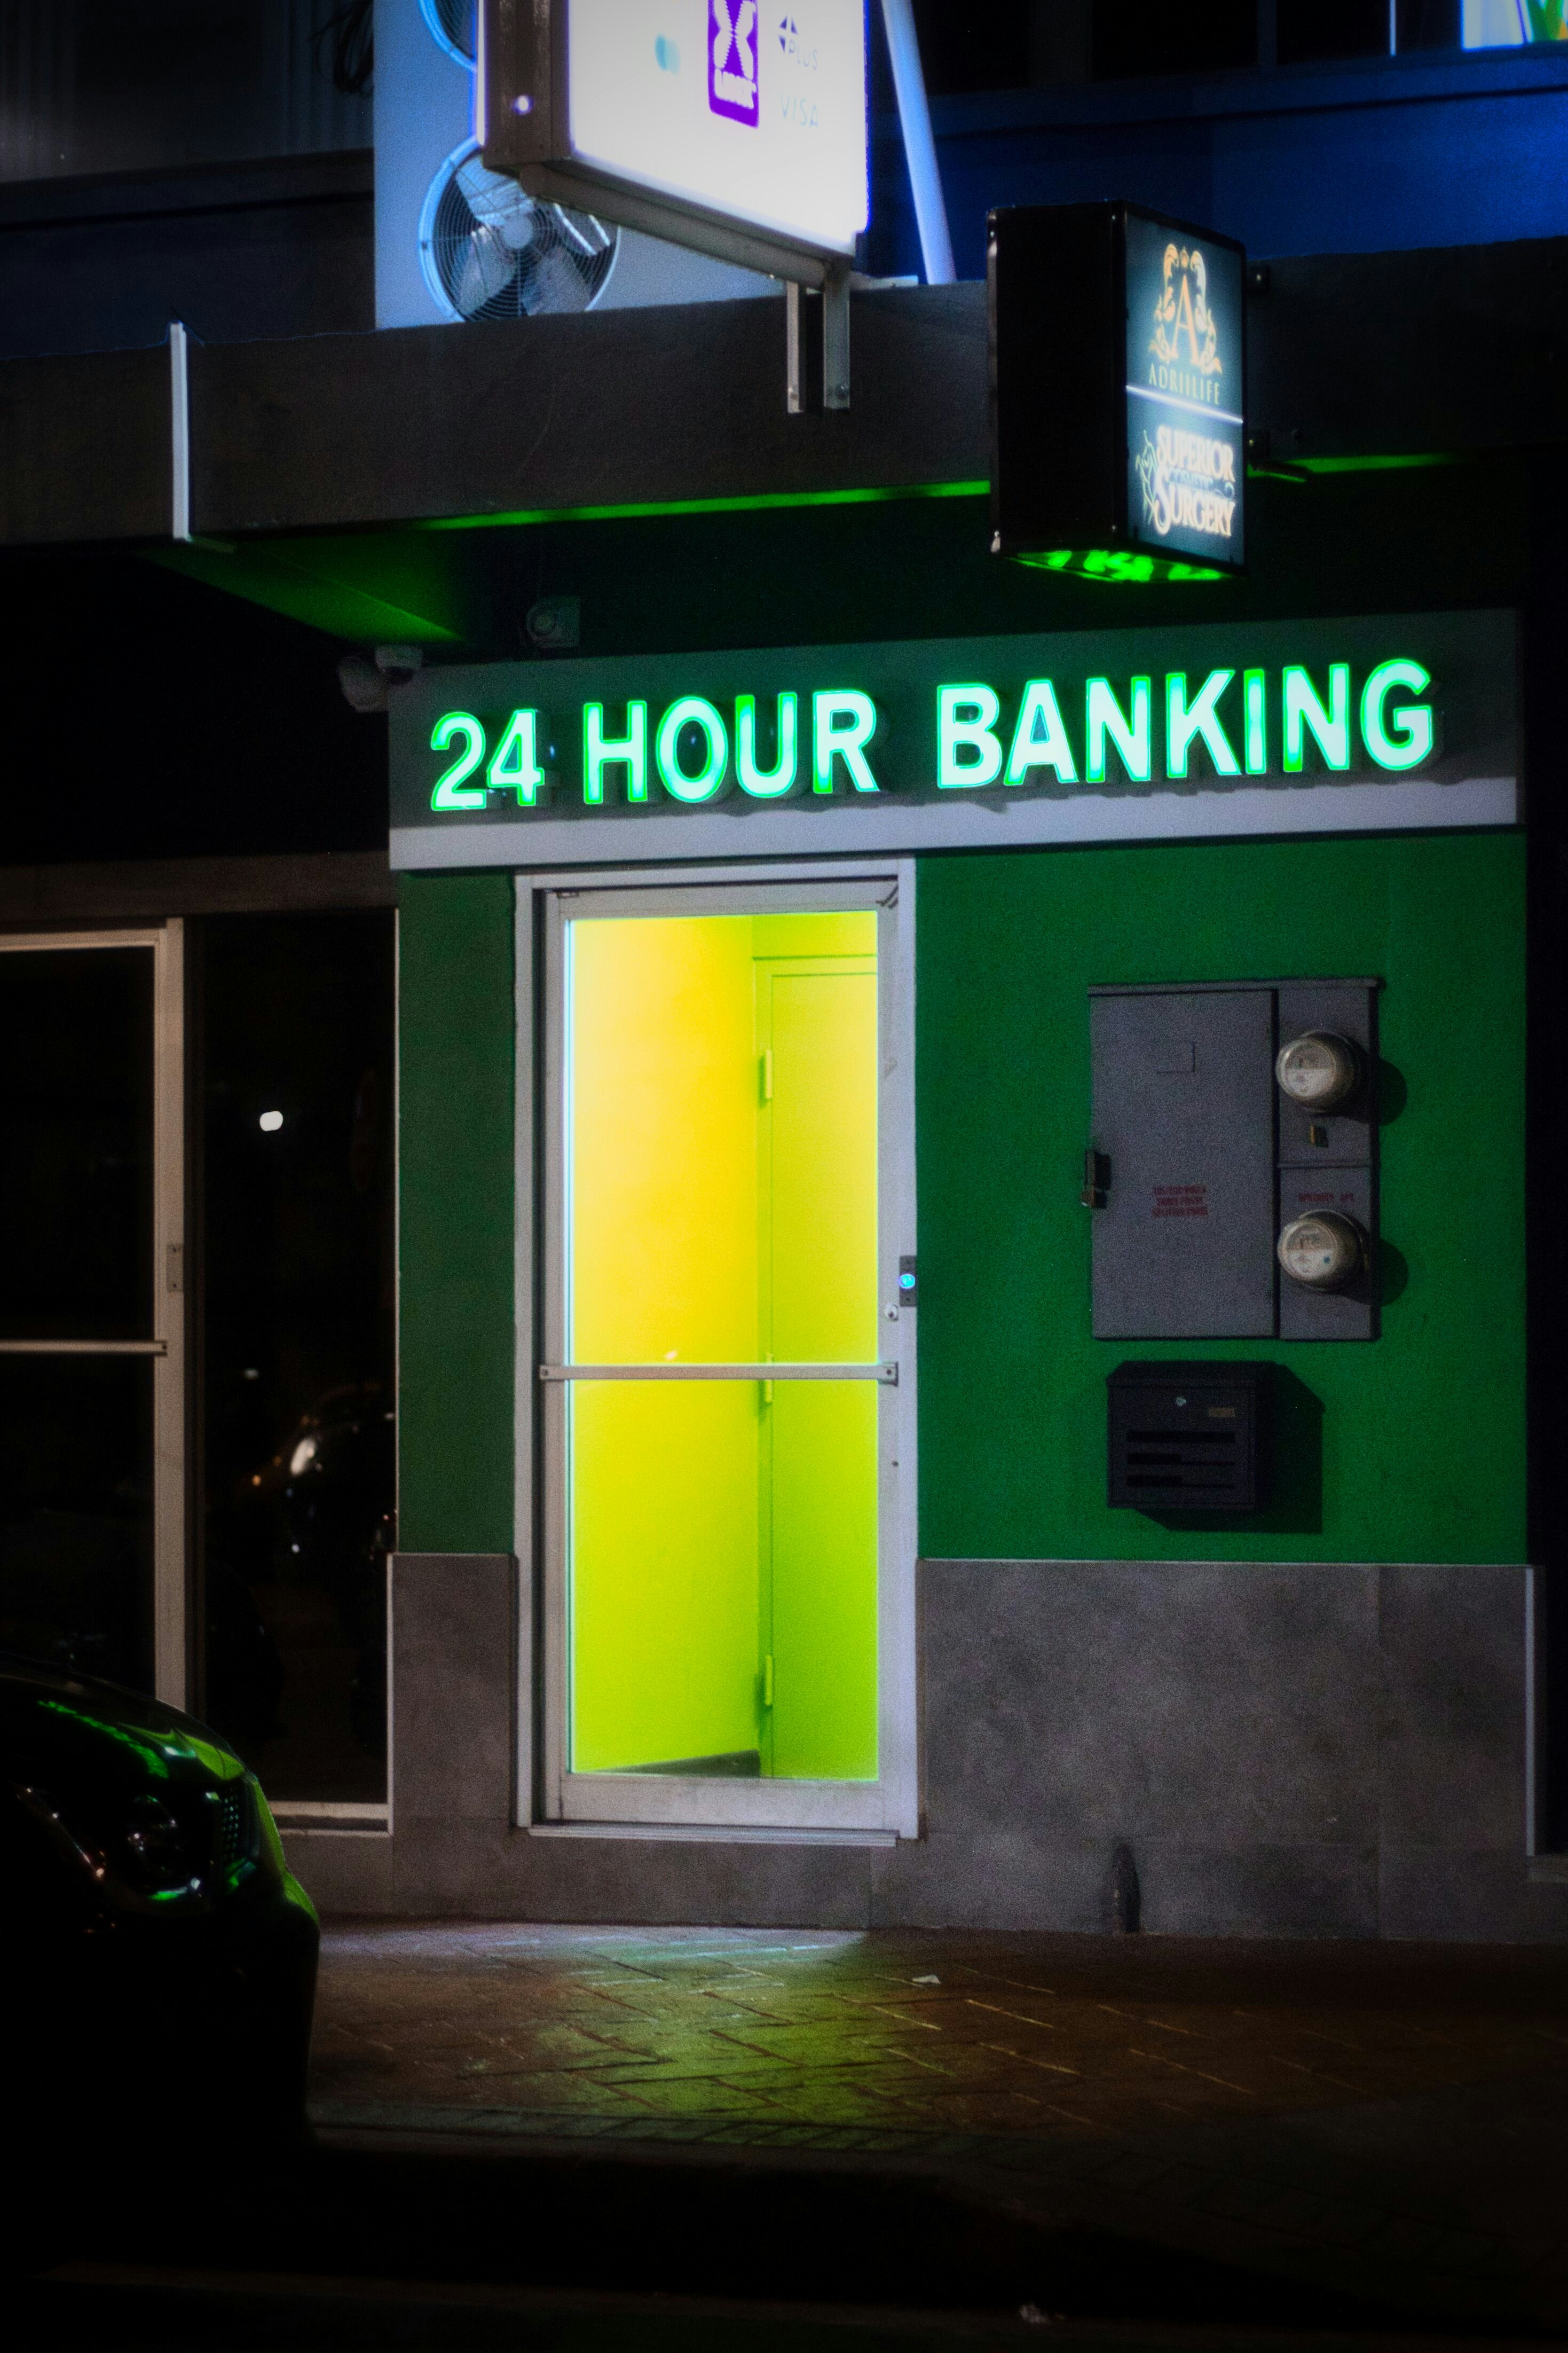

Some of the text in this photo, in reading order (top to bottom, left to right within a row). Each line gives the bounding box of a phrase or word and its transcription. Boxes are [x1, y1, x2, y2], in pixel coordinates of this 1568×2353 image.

[788, 38, 818, 71] PLUS
[780, 91, 820, 129] VISA
[1156, 425, 1236, 482] SUPERIOR
[1154, 464, 1236, 537] SURGERY
[431, 659, 1434, 811] 24 HOUR BANKING
